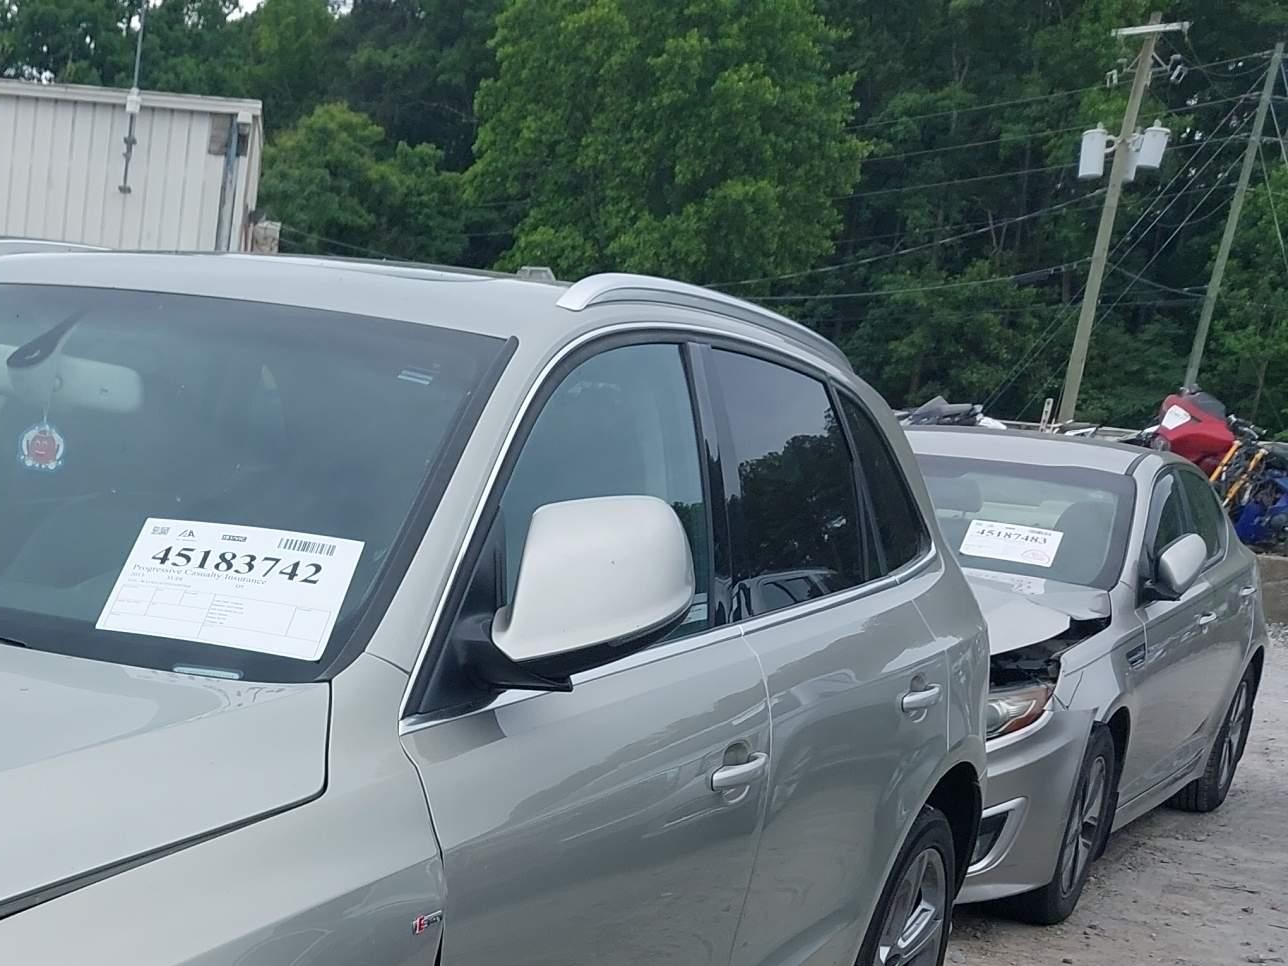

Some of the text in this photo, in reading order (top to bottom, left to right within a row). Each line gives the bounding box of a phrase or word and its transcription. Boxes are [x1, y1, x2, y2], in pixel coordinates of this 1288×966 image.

[976, 528, 1048, 545] 45187483
[132, 564, 183, 577] Progressive
[184, 569, 223, 581] Casualty
[223, 573, 268, 585] Insurance
[151, 545, 323, 585] 45183742
